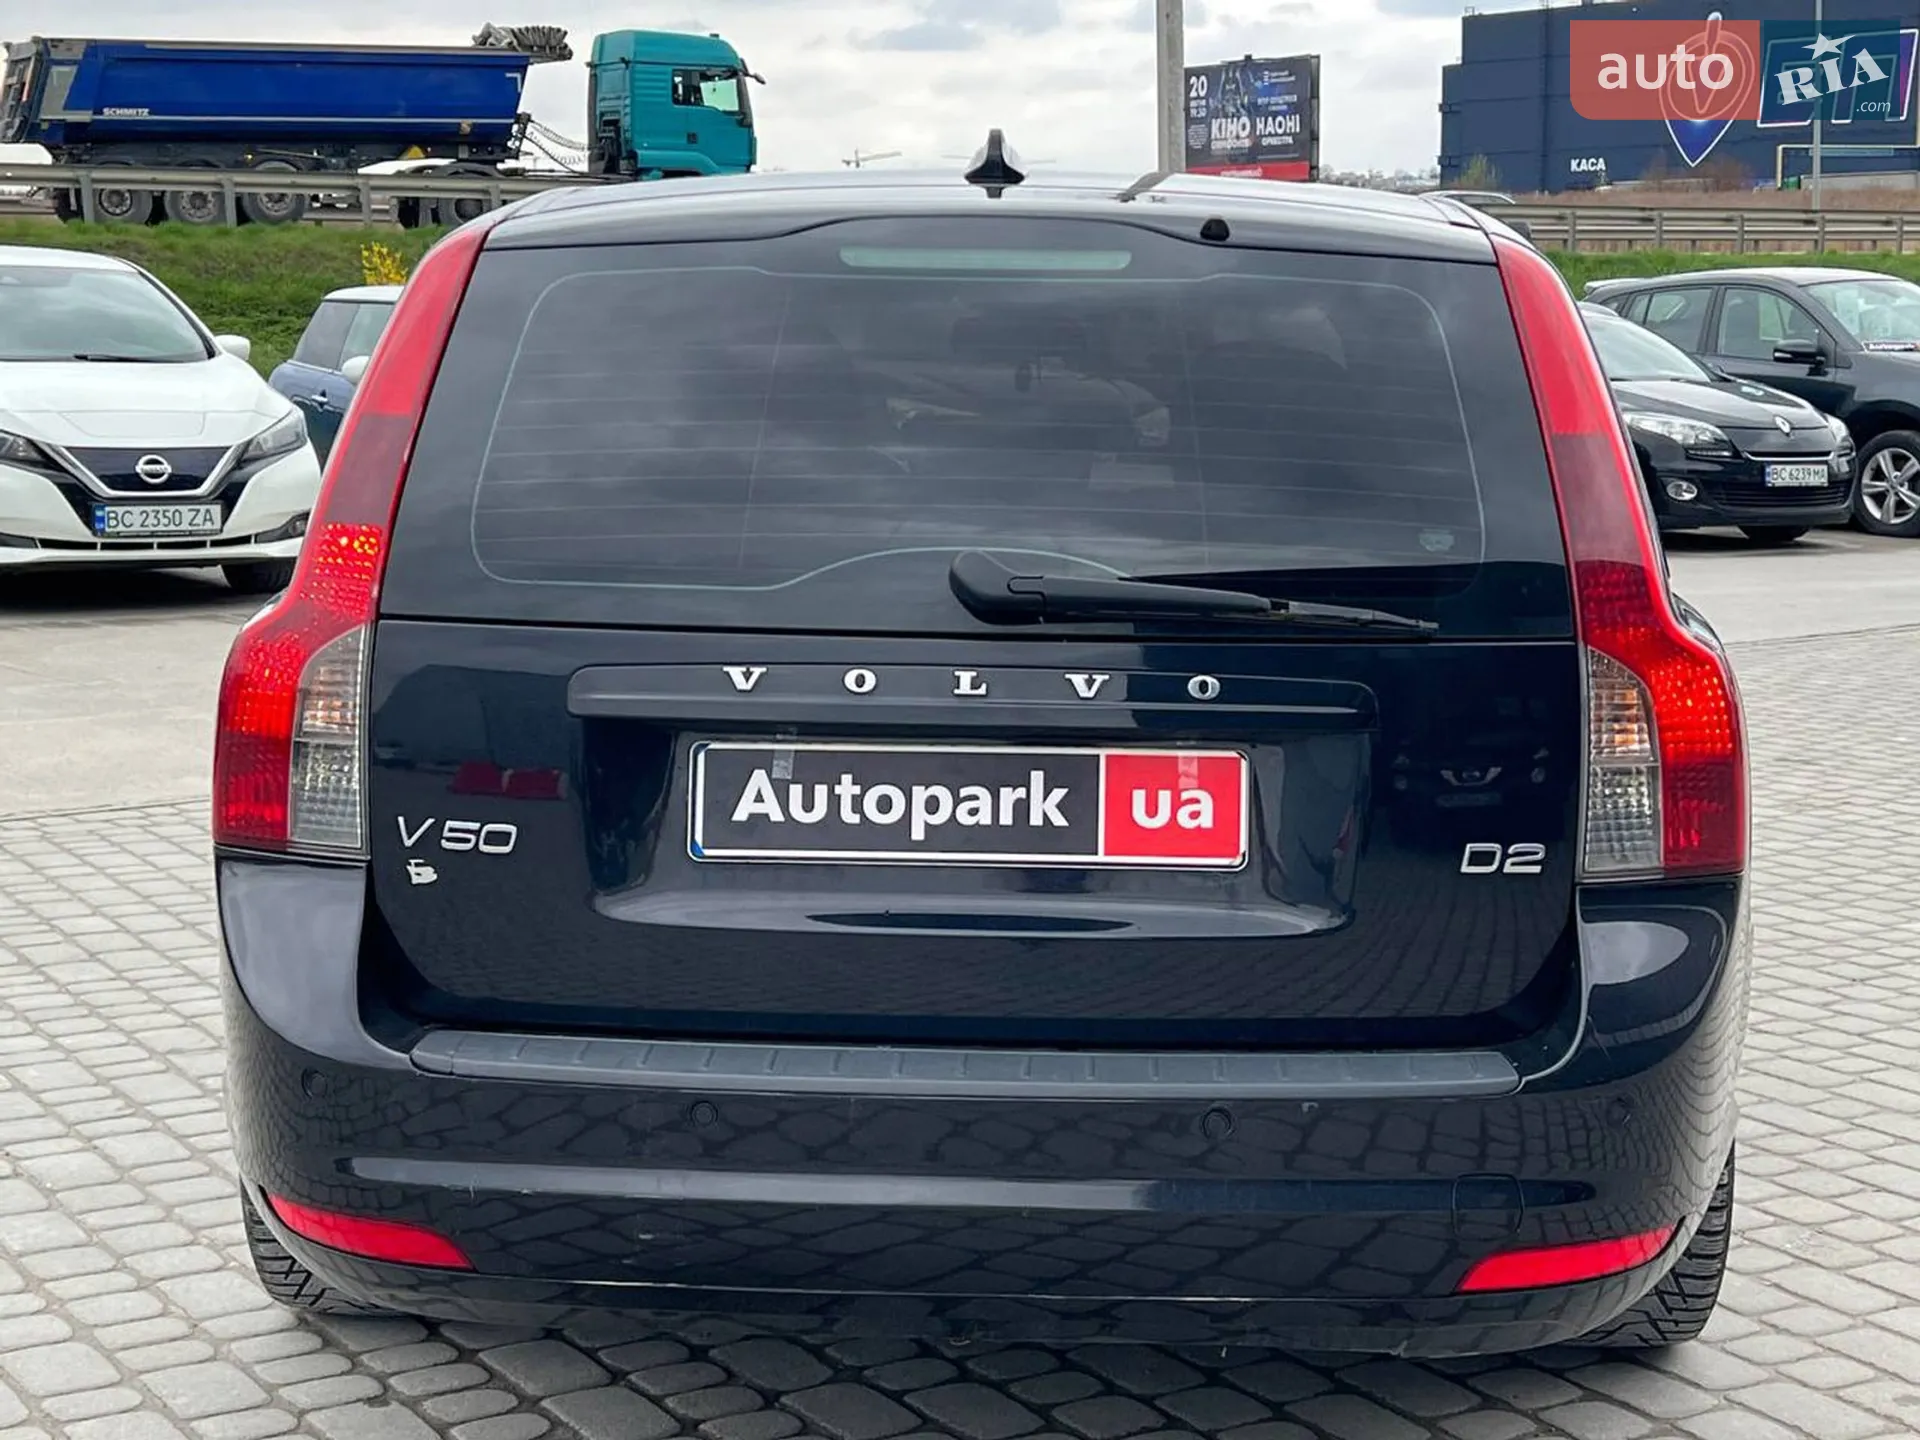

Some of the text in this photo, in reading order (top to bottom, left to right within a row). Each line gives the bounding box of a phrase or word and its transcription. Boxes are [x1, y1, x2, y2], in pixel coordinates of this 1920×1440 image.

[1189, 75, 1208, 97] 20
[102, 106, 150, 117] SCHMITZ
[1211, 115, 1251, 139] КІНО
[1256, 113, 1301, 136] НАОНІ
[1570, 157, 1606, 172] КАСА
[1771, 467, 1787, 481] BC
[106, 508, 215, 528] BC 2350 ZA
[722, 665, 1222, 700] VOLVO
[731, 767, 1214, 841] Autopark ua
[1459, 842, 1547, 874] D2
